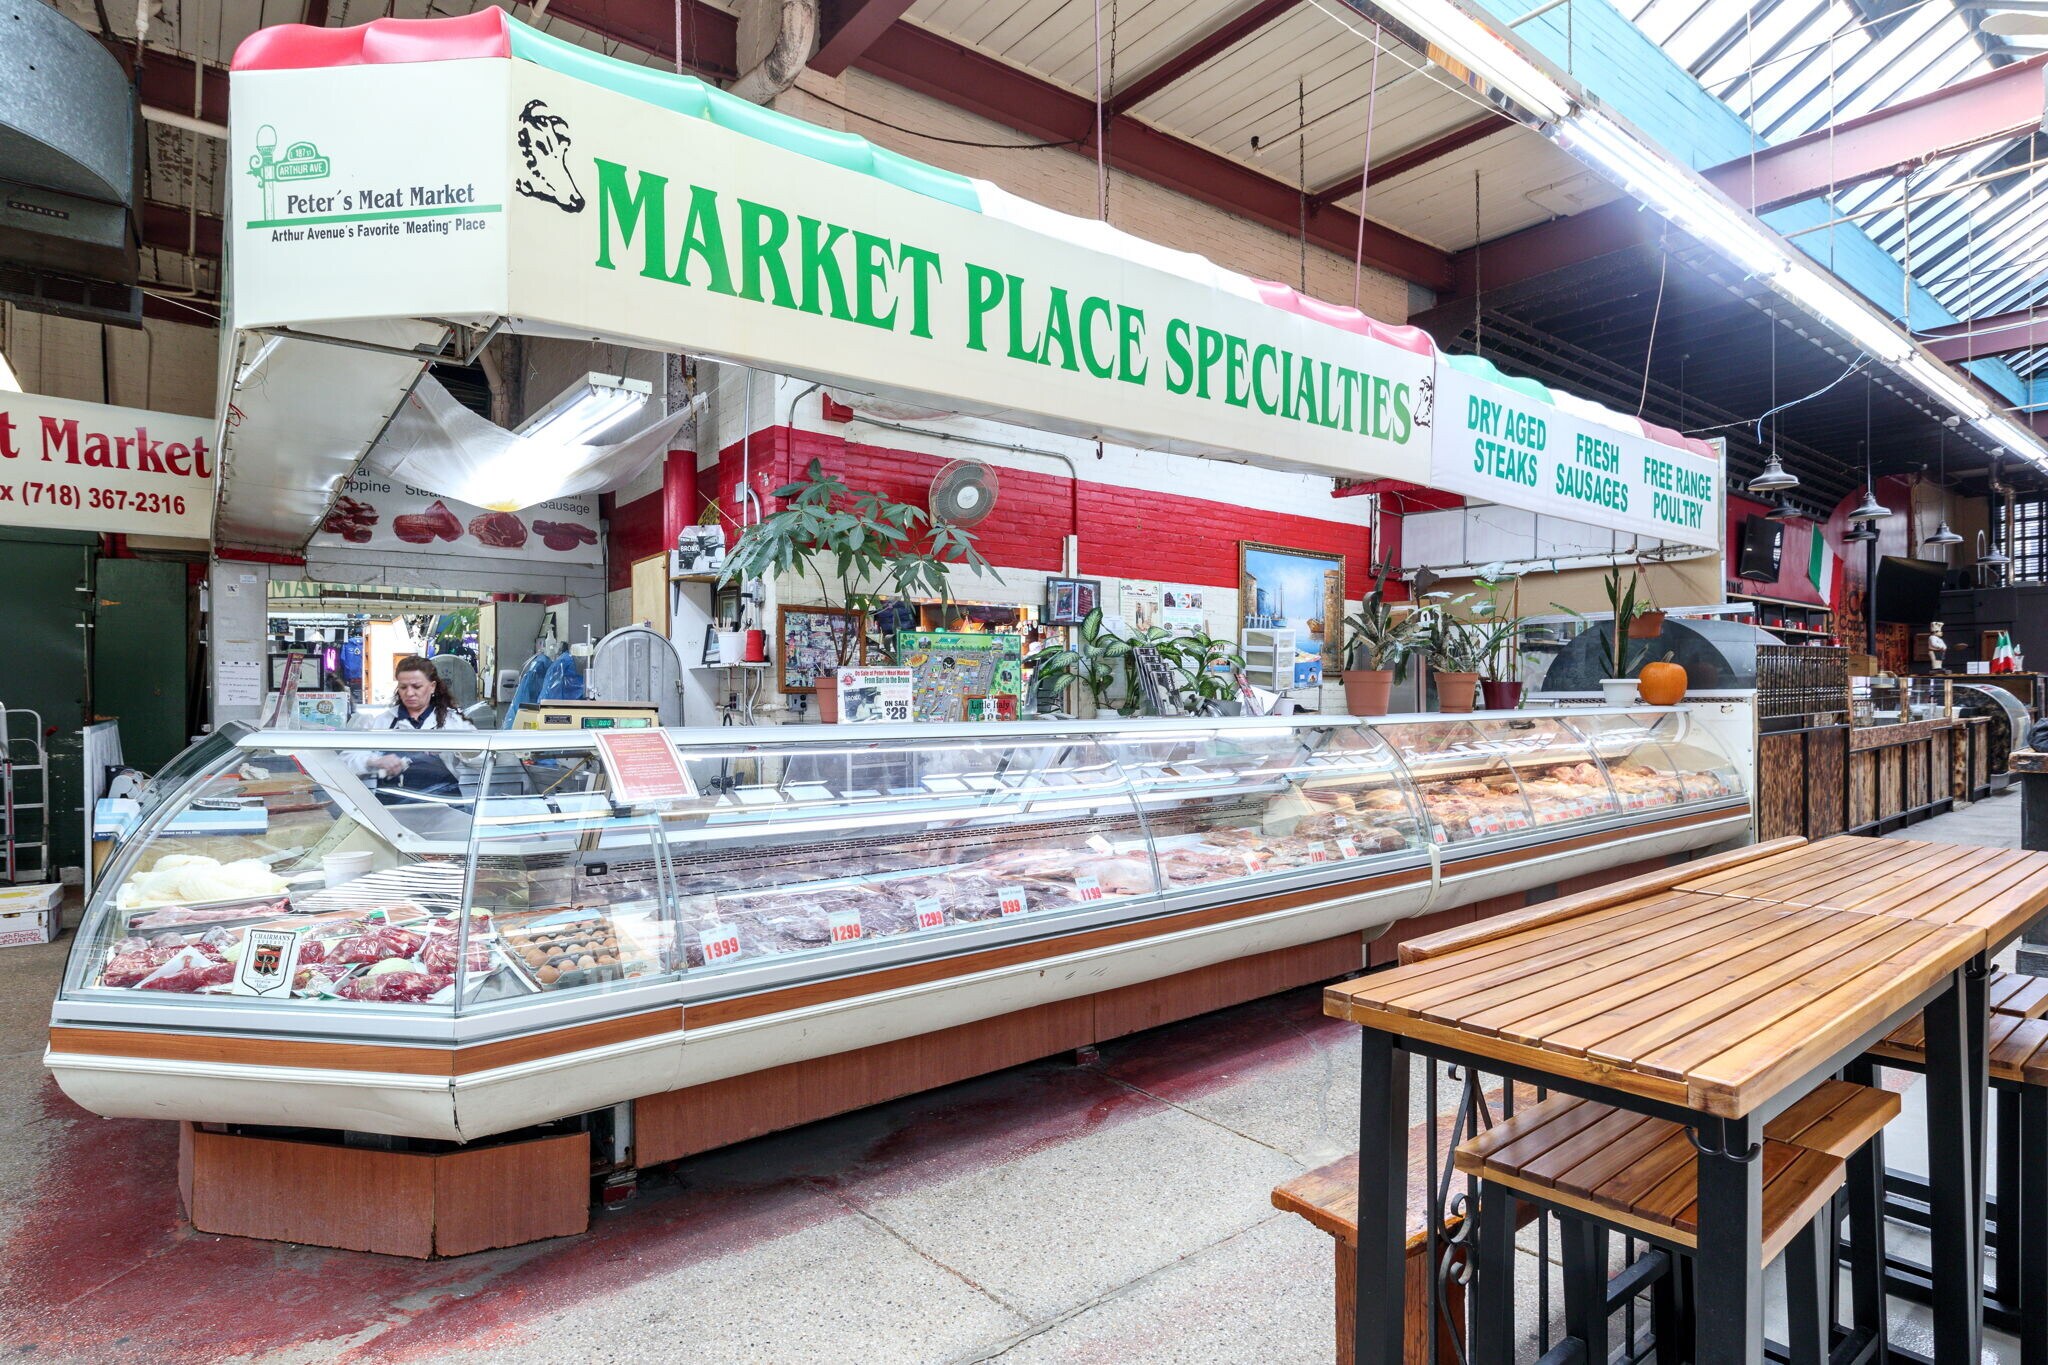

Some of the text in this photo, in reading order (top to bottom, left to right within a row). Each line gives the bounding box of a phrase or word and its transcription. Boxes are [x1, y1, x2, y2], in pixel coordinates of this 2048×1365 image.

[280, 165, 309, 176] ARTHUR
[359, 187, 404, 210] Meat
[410, 183, 475, 207] Market
[272, 229, 304, 243] Arthur
[357, 223, 400, 237] Favorite
[455, 217, 486, 231] Place
[593, 157, 1412, 445] MARKET PLACE SPECIALTIES
[1467, 394, 1546, 451] DRY AGED
[39, 415, 213, 478] Market
[1576, 432, 1620, 475] FRESH
[1473, 438, 1538, 487] STEAKS
[1556, 463, 1628, 513] SAUSAGES
[1644, 456, 1712, 502] FREE RANGE
[22, 481, 81, 509] (718)
[88, 487, 186, 515] 367-2316
[1653, 492, 1703, 530] POULTRY
[885, 706, 907, 720] $28
[894, 699, 909, 707] SALE
[971, 699, 1010, 711] Little Italy
[1002, 899, 1020, 914] 999
[832, 923, 861, 941] 1299
[705, 937, 739, 960] 1999
